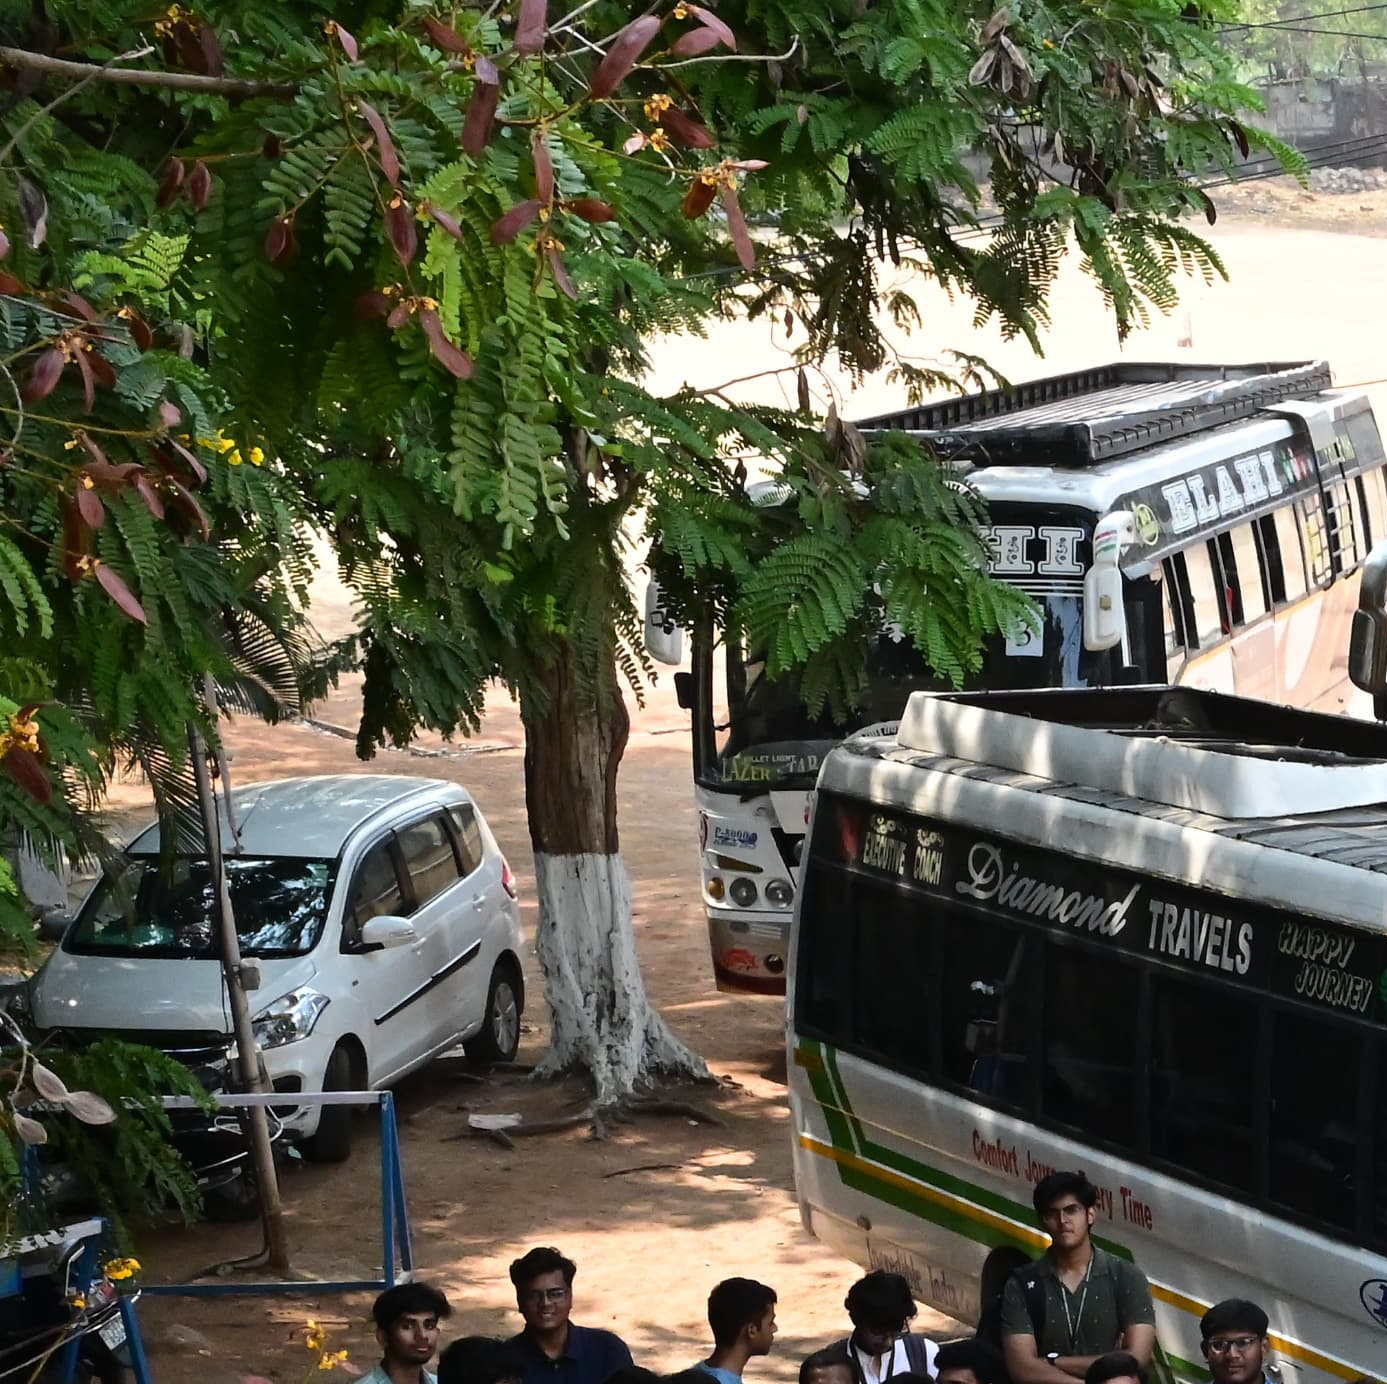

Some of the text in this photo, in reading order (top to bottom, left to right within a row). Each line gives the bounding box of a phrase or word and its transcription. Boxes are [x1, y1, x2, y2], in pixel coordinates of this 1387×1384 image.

[1161, 450, 1283, 535] ELAHI
[863, 832, 944, 886] EXECUTIVE COACH
[955, 842, 1254, 975] Diamond TRAVELS
[1278, 921, 1356, 969] HAPPY
[1295, 962, 1374, 1013] JOURNEY
[972, 1128, 1020, 1176] Comfort
[1119, 1186, 1154, 1231] Time
